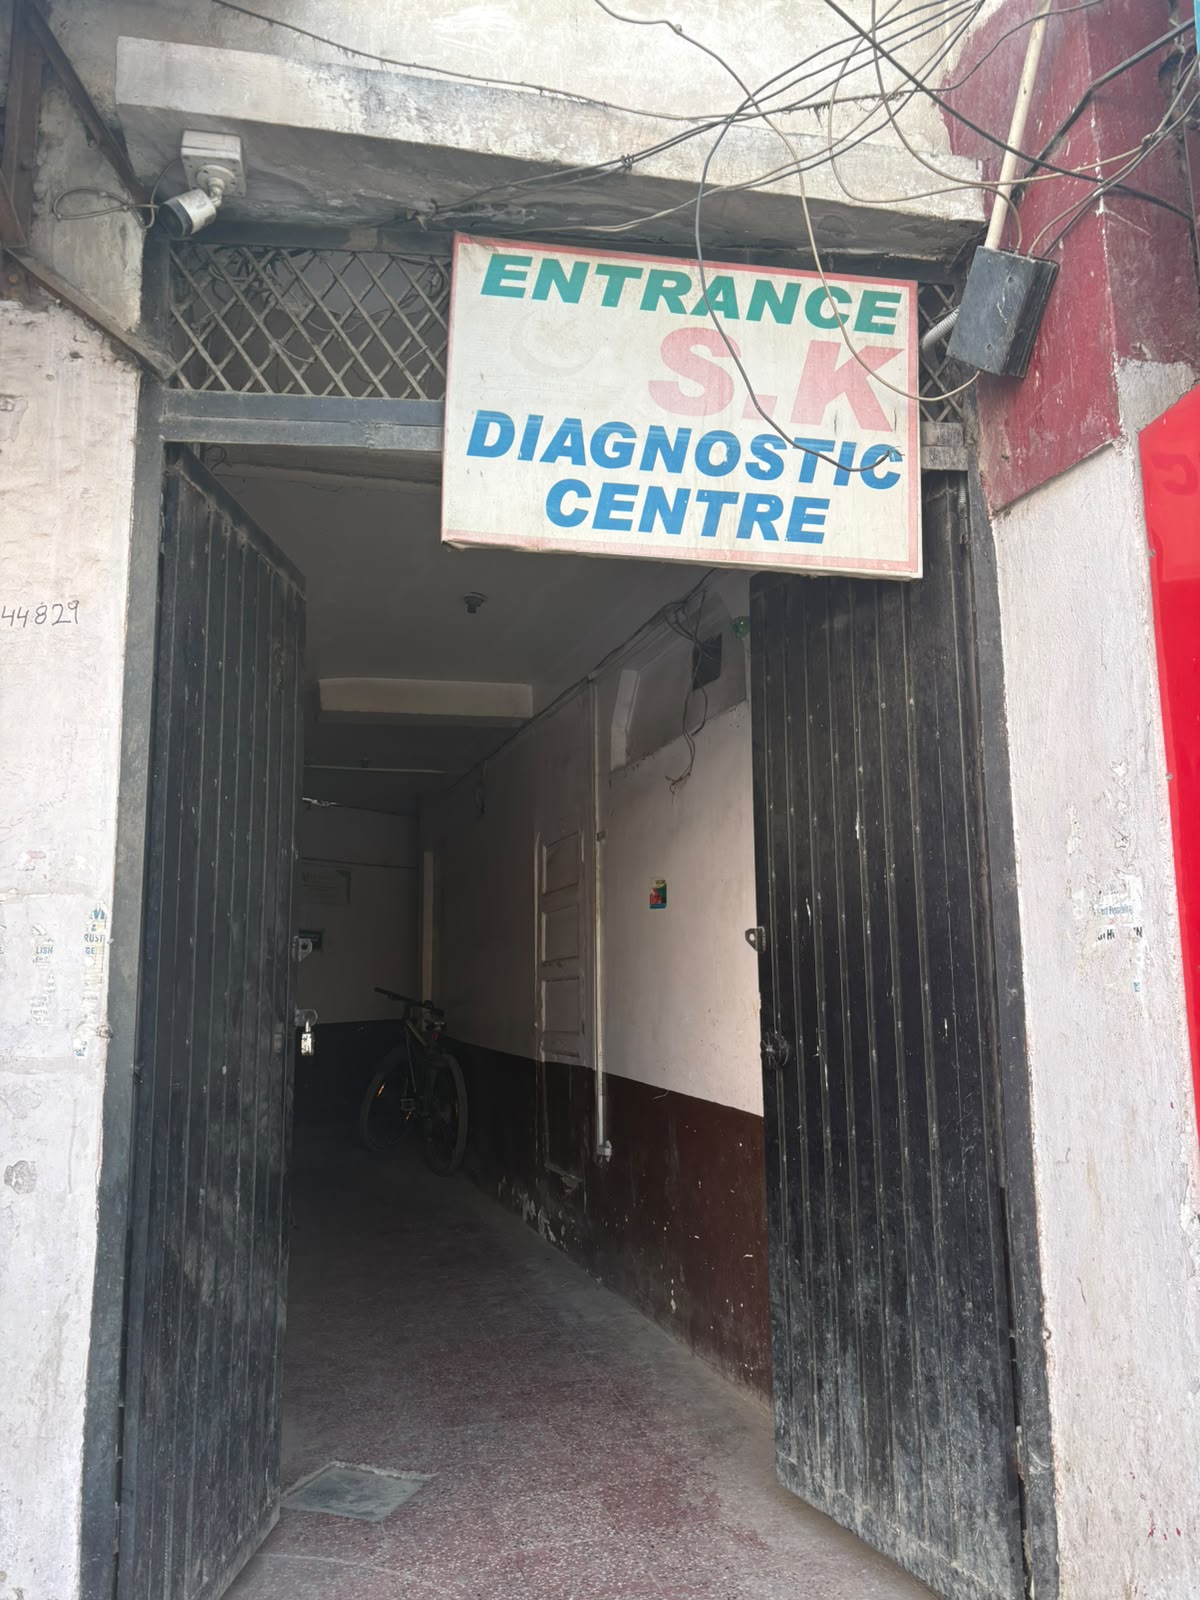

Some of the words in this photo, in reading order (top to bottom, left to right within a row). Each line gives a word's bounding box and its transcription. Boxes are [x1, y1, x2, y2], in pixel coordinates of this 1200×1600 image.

[480, 254, 902, 335] ENTRANCE
[648, 326, 904, 432] S.K
[467, 410, 901, 490] DIAGNOSTIC
[545, 479, 830, 544] CENTRE
[1, 600, 80, 628] 44829
